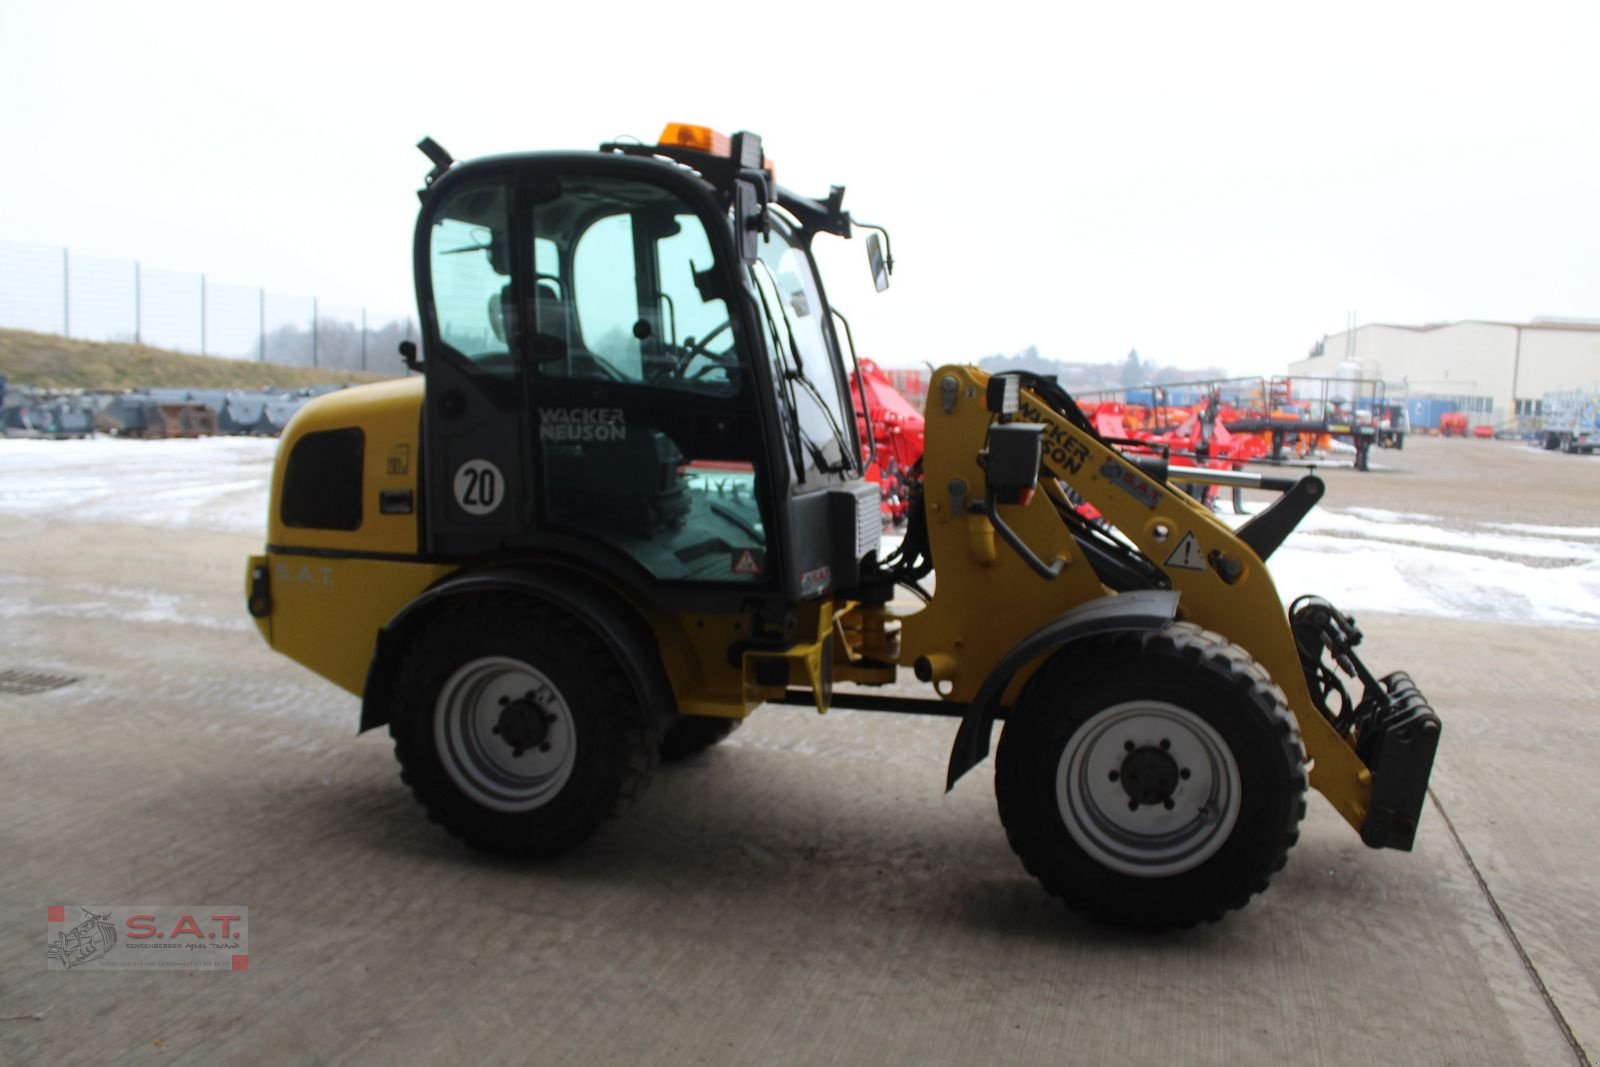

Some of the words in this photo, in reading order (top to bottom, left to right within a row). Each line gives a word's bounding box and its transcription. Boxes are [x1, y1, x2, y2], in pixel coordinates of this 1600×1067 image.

[539, 407, 625, 423] WACKER
[540, 424, 627, 441] NEUSON
[1042, 439, 1083, 475] SON
[463, 467, 495, 507] 20
